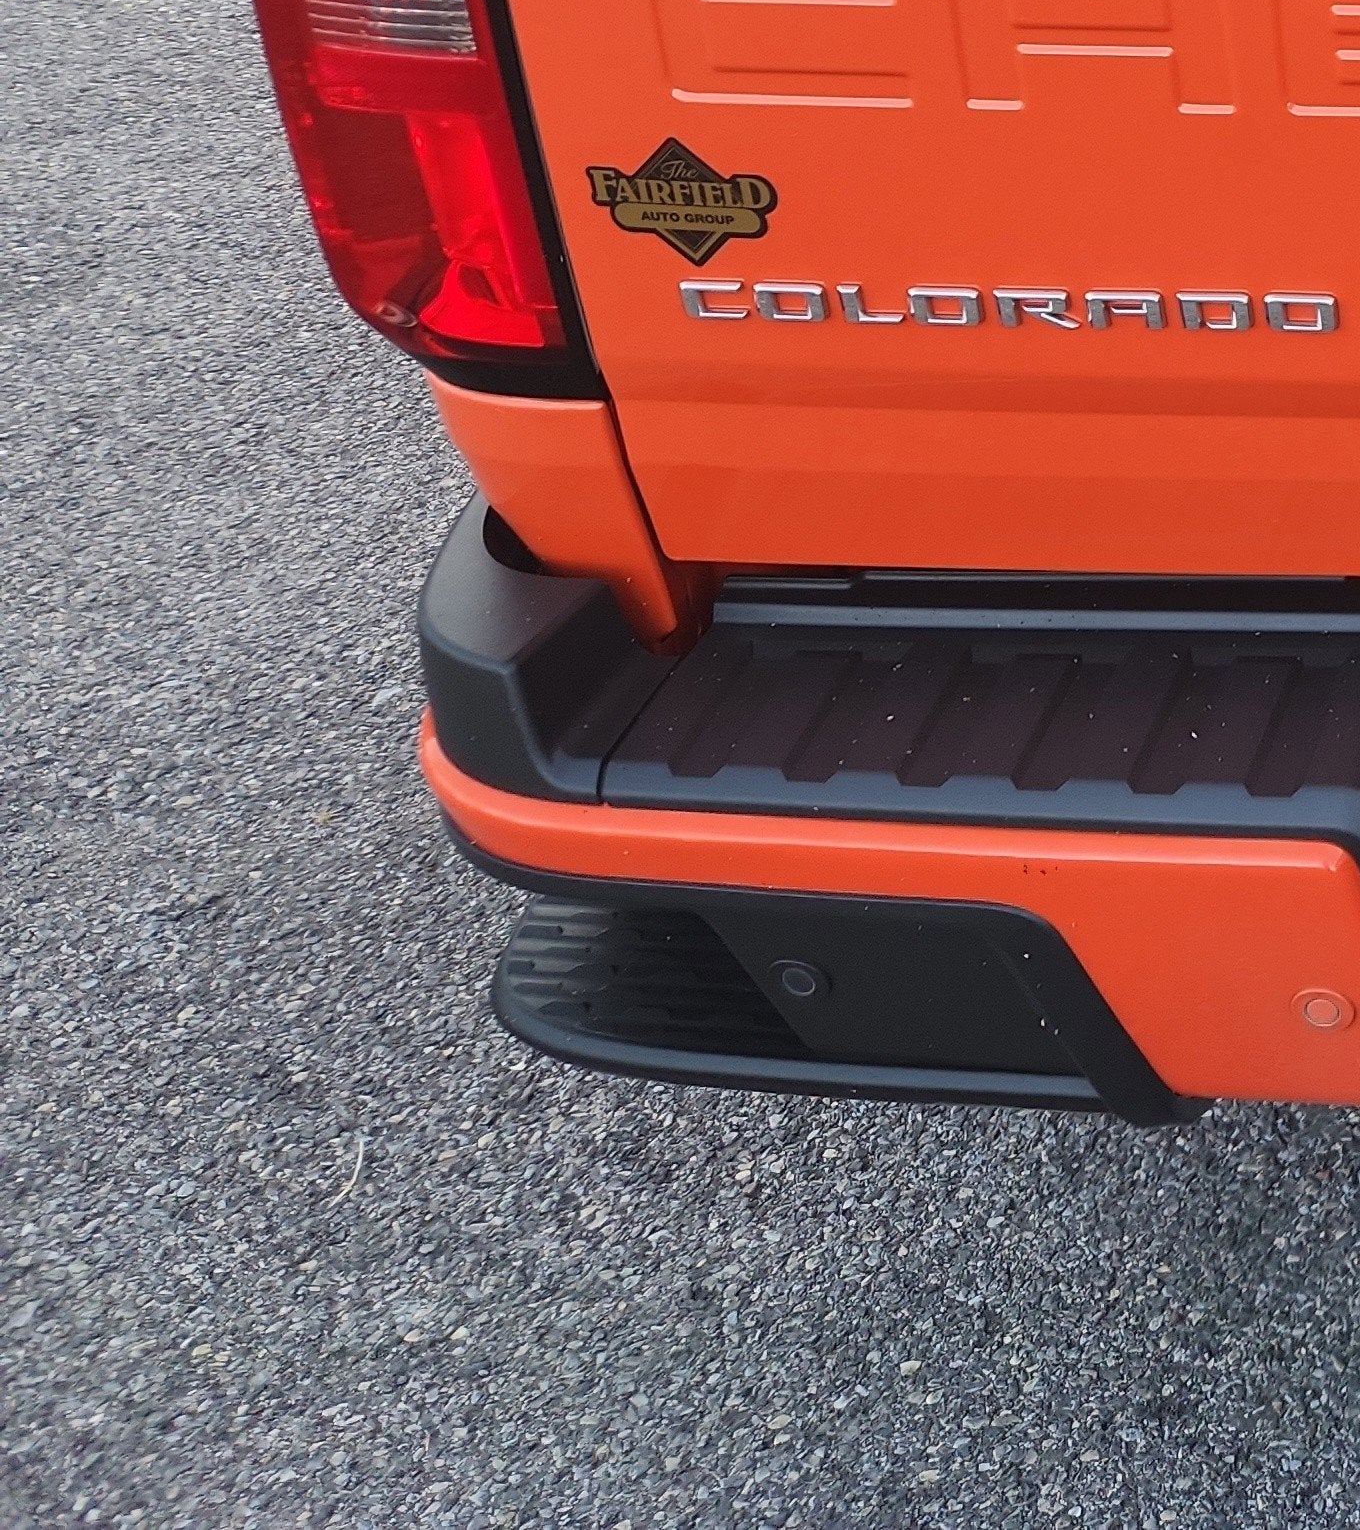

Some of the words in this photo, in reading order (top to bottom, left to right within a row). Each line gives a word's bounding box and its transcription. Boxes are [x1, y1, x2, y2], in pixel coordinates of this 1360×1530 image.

[660, 159, 700, 180] The
[588, 168, 772, 210] FAIRFIELD
[641, 210, 680, 223] AUTO
[684, 213, 735, 226] GROUP
[679, 277, 1341, 335] COLORADO
